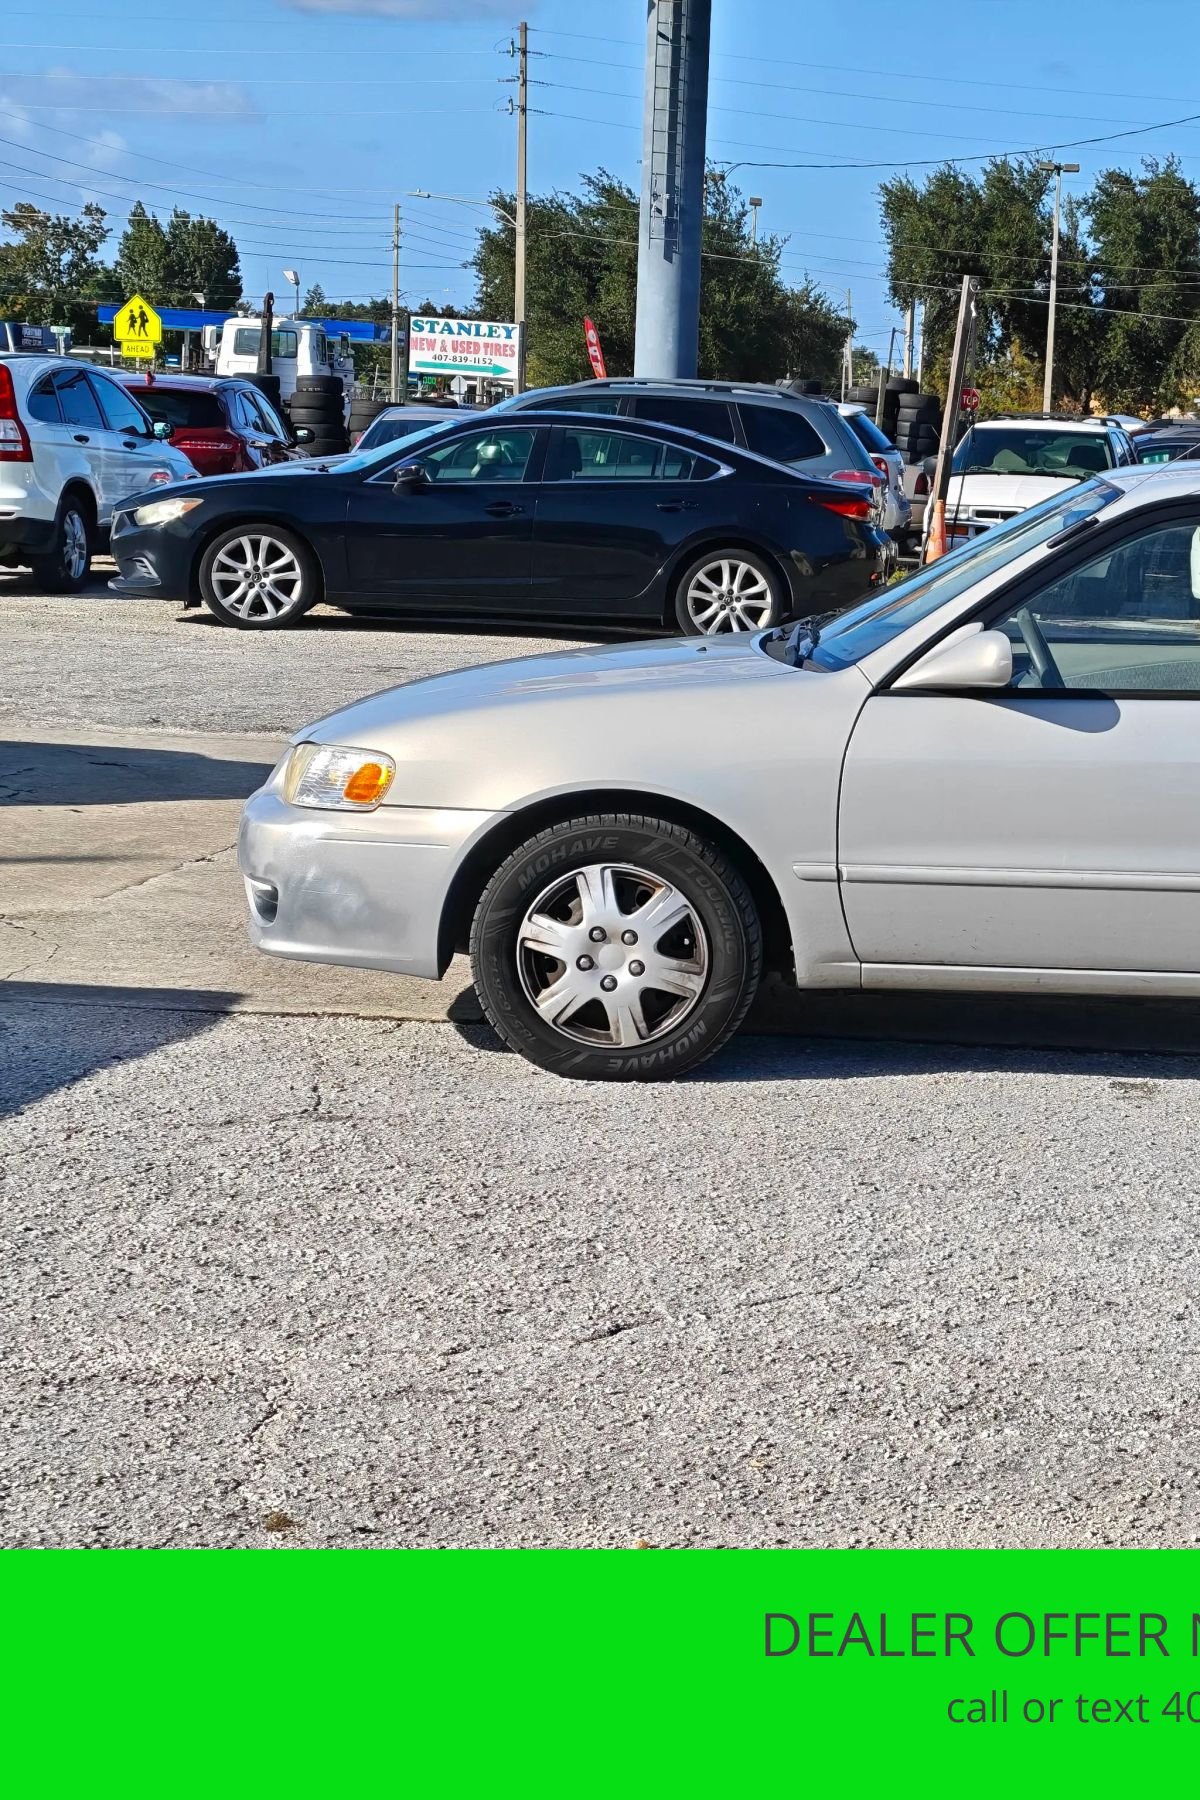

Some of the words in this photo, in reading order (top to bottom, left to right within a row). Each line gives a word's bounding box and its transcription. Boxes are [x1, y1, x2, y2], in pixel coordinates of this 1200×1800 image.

[412, 319, 517, 339] STANLEY
[126, 344, 150, 353] AHEAD
[411, 337, 436, 351] NEW
[439, 339, 448, 353] &
[451, 340, 480, 354] USED
[483, 342, 516, 358] TIRES
[432, 354, 493, 365] 407-839-1152
[962, 395, 978, 406] TOP
[517, 835, 619, 891] MOHAVE
[685, 864, 740, 954] TOURING
[603, 1019, 710, 1073] MOHAVE
